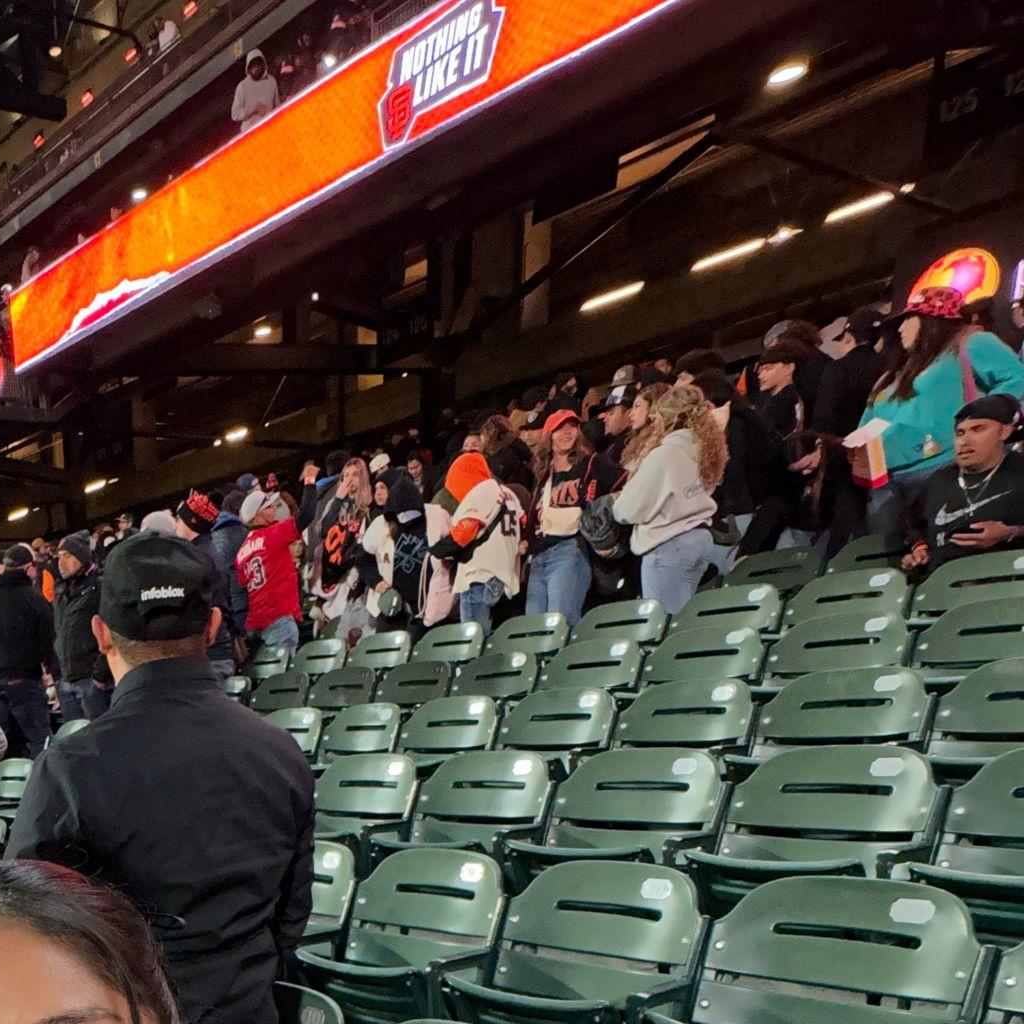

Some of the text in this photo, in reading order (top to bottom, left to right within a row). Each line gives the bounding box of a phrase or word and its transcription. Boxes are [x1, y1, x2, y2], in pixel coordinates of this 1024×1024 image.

[399, 2, 483, 86] NOTHING
[413, 24, 489, 107] LIKE IT
[386, 83, 413, 141] SF
[141, 585, 184, 601] infoblox
